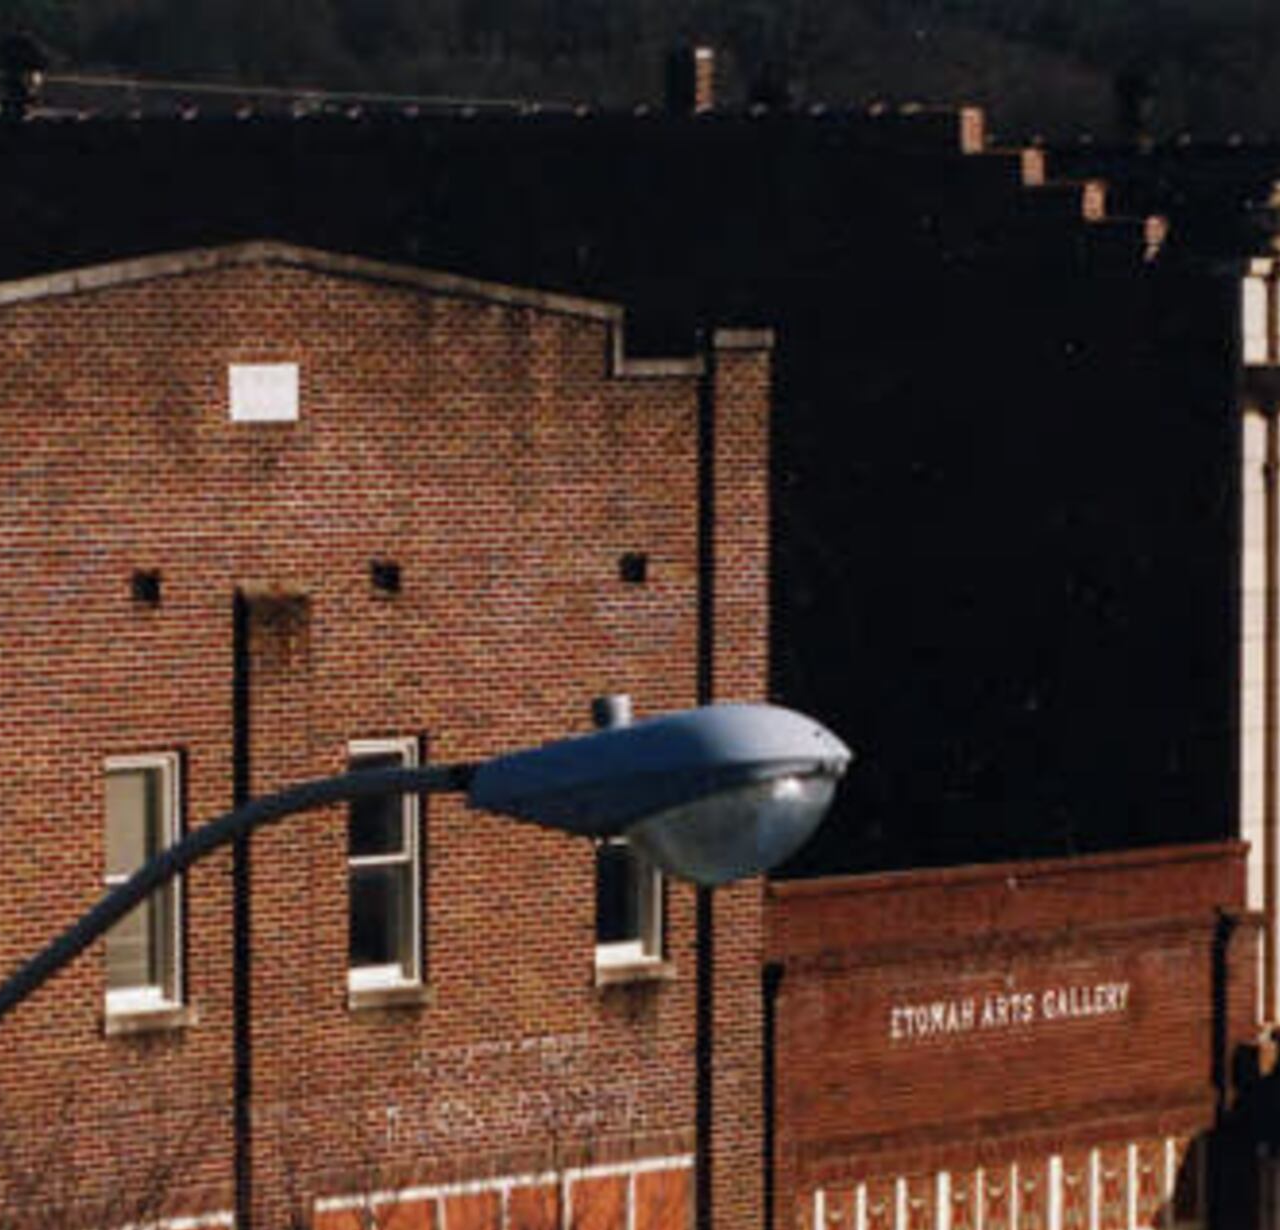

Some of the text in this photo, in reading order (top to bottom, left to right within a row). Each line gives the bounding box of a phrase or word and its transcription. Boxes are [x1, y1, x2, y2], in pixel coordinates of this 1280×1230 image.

[890, 982, 1129, 1038] ETOWAH ARTS GALLERY
